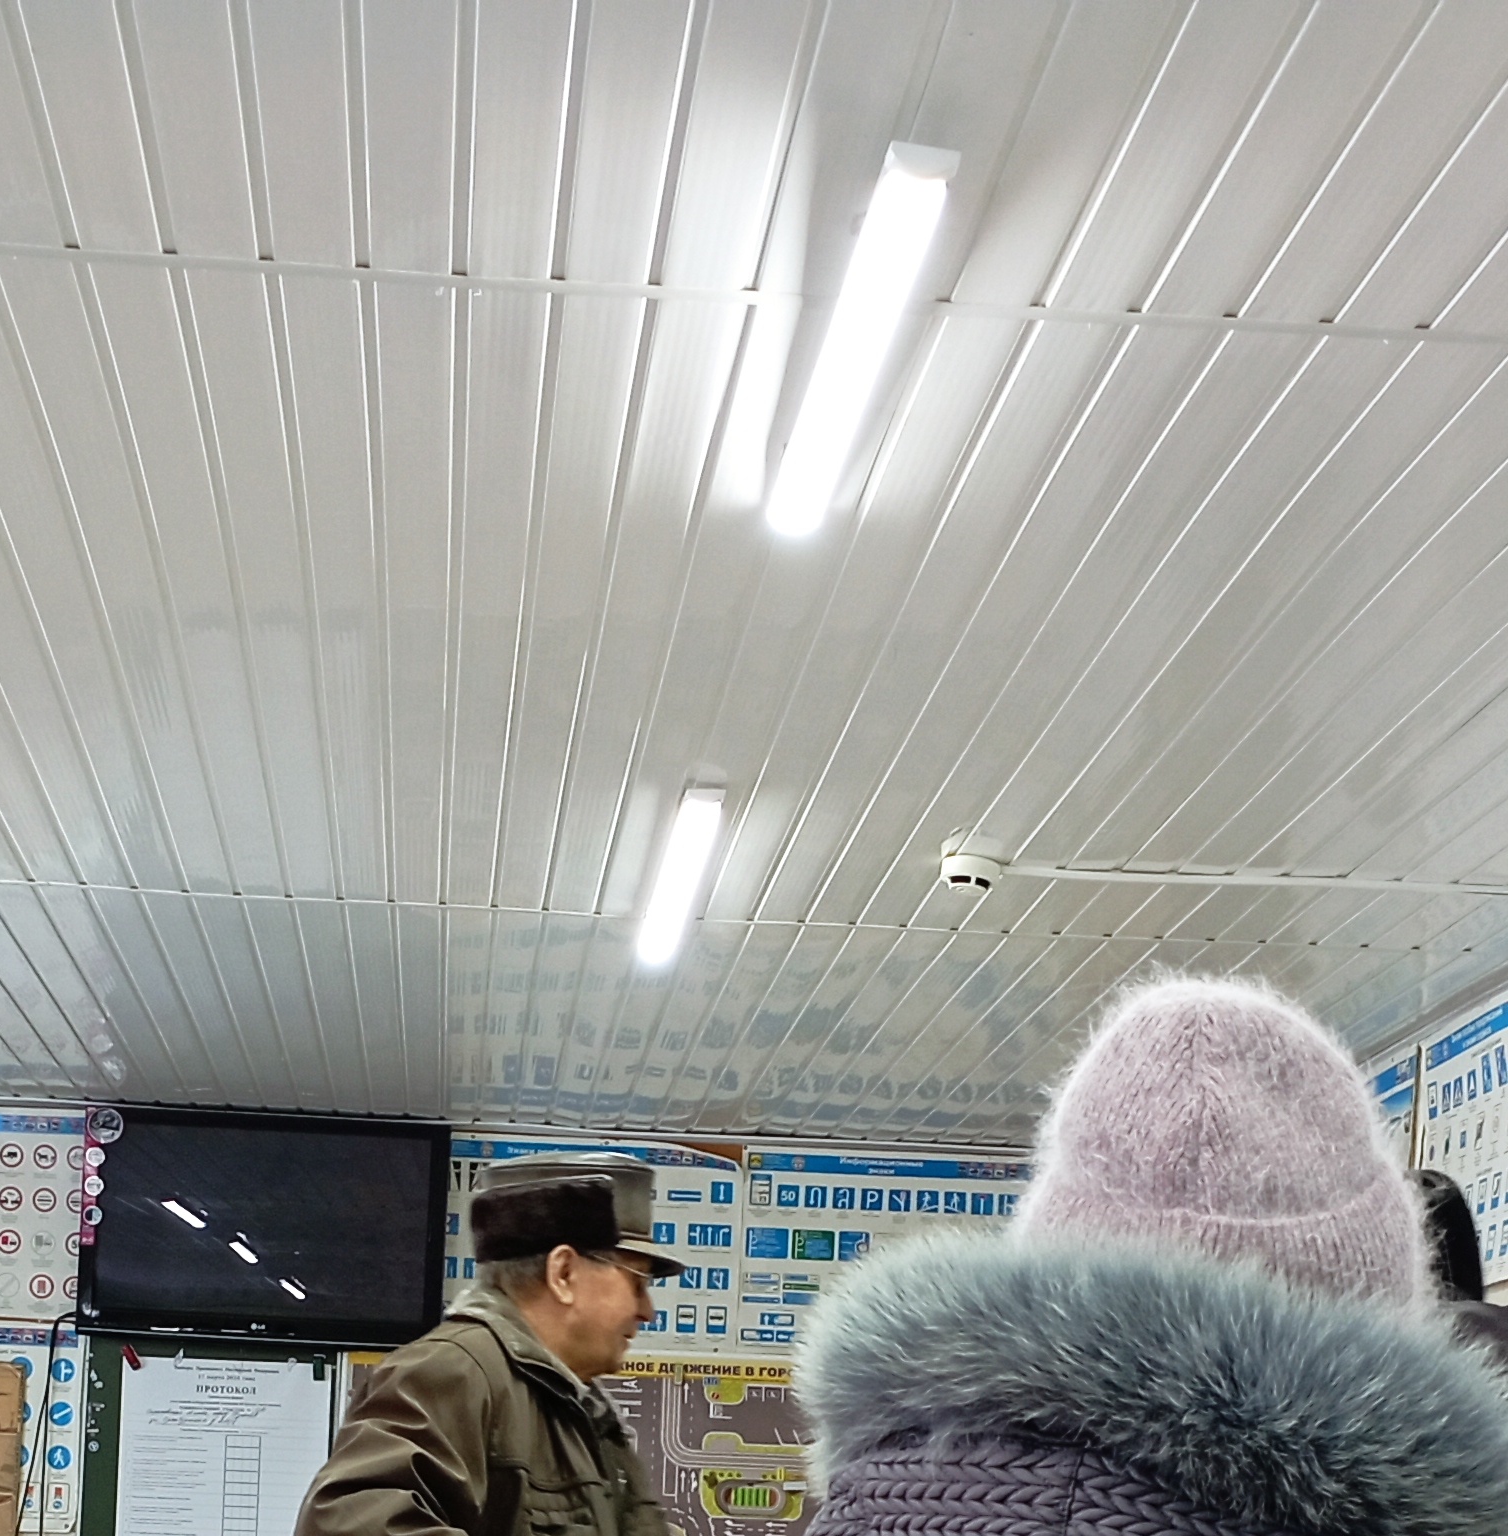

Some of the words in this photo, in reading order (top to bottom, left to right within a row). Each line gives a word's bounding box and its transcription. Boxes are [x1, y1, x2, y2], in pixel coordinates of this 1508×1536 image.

[780, 1190, 796, 1202] 50
[620, 1361, 654, 1373] НОЕ
[745, 1366, 755, 1377] В
[195, 1384, 257, 1395] ПРОТОКОЛ
